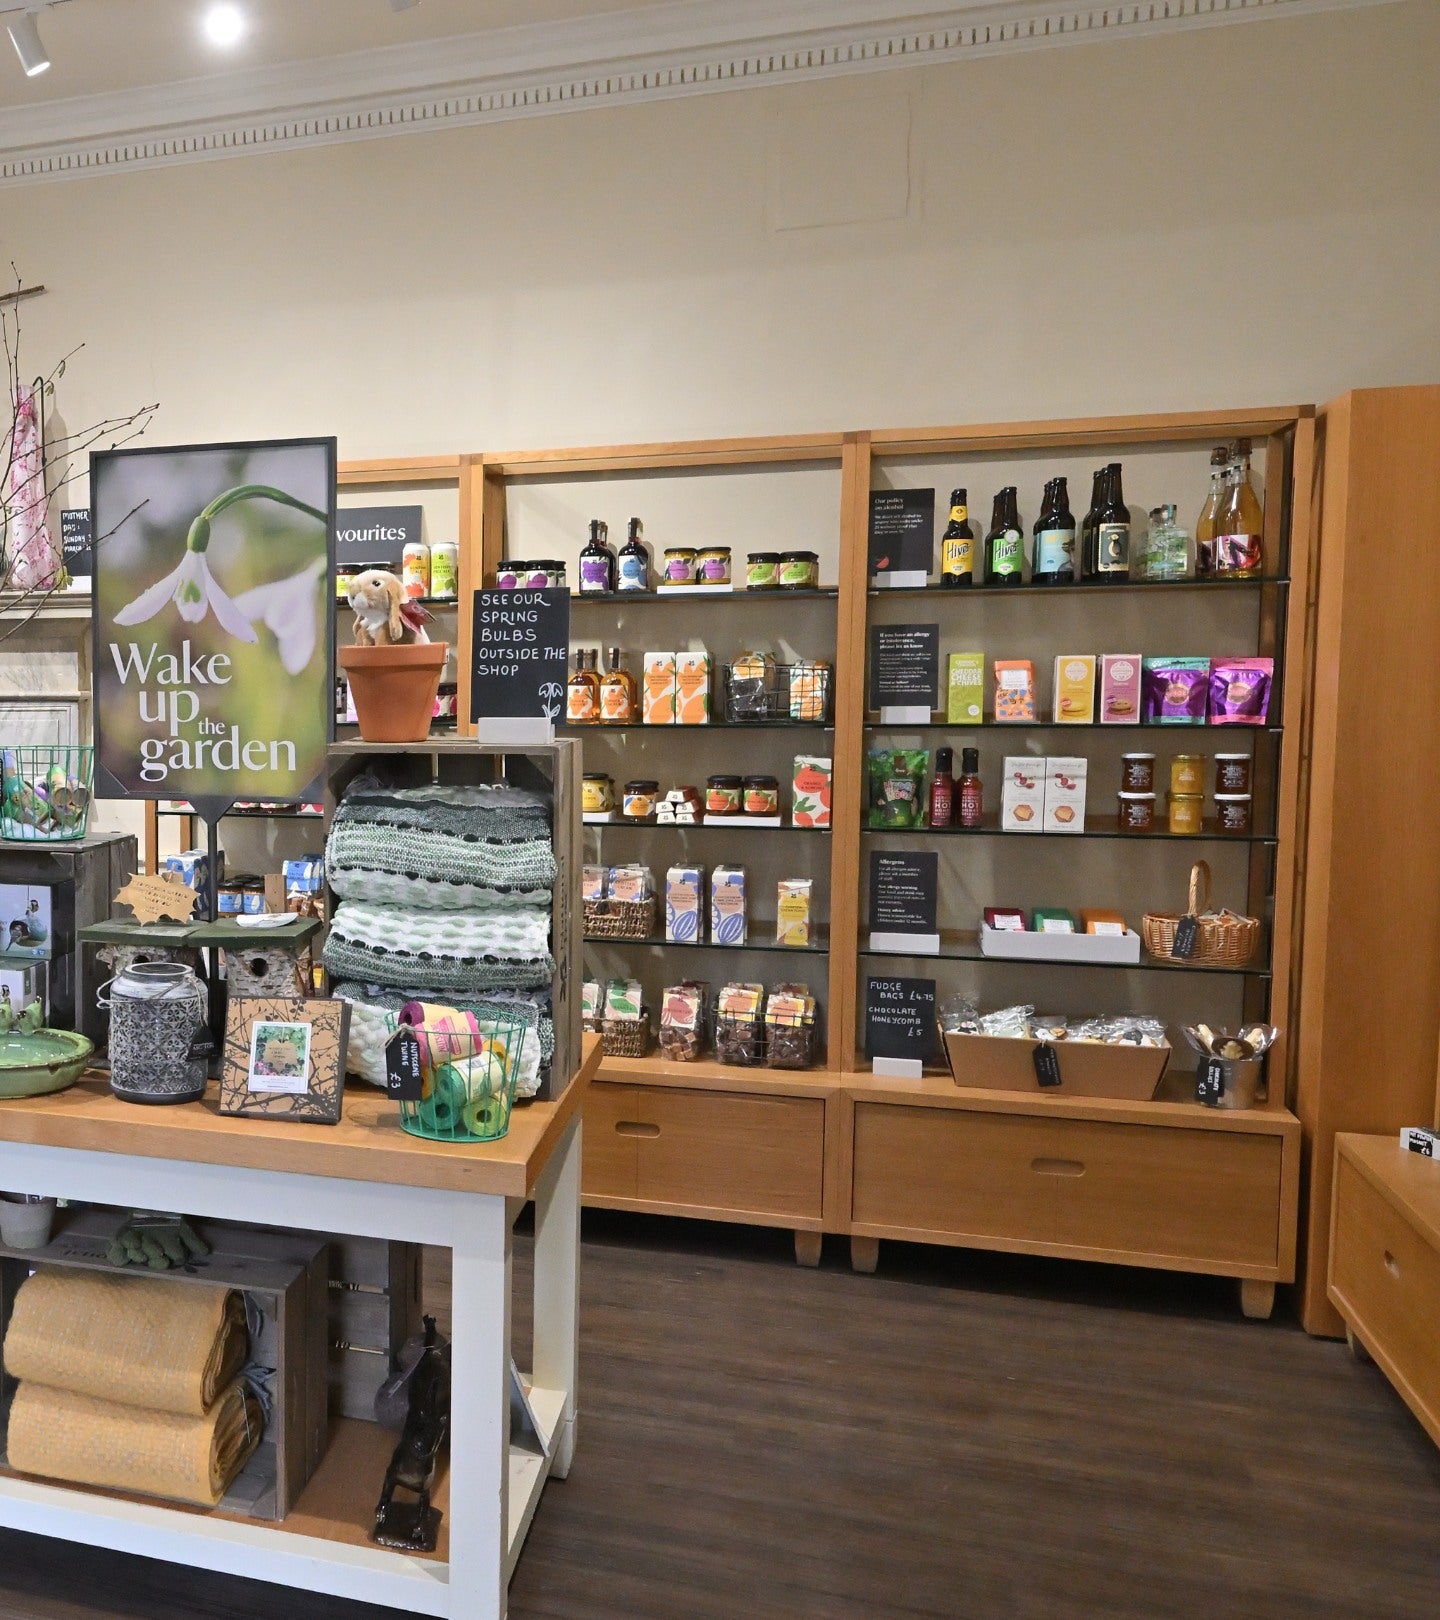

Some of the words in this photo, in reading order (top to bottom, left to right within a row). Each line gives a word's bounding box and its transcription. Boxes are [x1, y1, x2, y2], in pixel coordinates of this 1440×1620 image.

[62, 509, 90, 521] MOTHER'
[336, 524, 407, 542] vourites
[481, 594, 509, 606] SEE
[513, 593, 551, 606] OUR
[480, 610, 538, 625] SPRING
[481, 628, 537, 642] BULBS
[479, 647, 539, 659] OUTSIDE
[543, 647, 566, 659] THE
[109, 640, 233, 685] Wake
[477, 664, 519, 676] SHOP
[138, 689, 200, 736] up
[198, 717, 226, 736] the
[139, 725, 297, 782] garden
[870, 981, 902, 991] FUDGE
[880, 992, 904, 1000] BAGS
[869, 1006, 917, 1015] CHOCOLATE
[871, 1015, 921, 1025] HONEYCOMB
[400, 1041, 409, 1067] TWINE
[410, 1041, 420, 1078] NUTSCENE
[389, 1071, 401, 1089] £3
